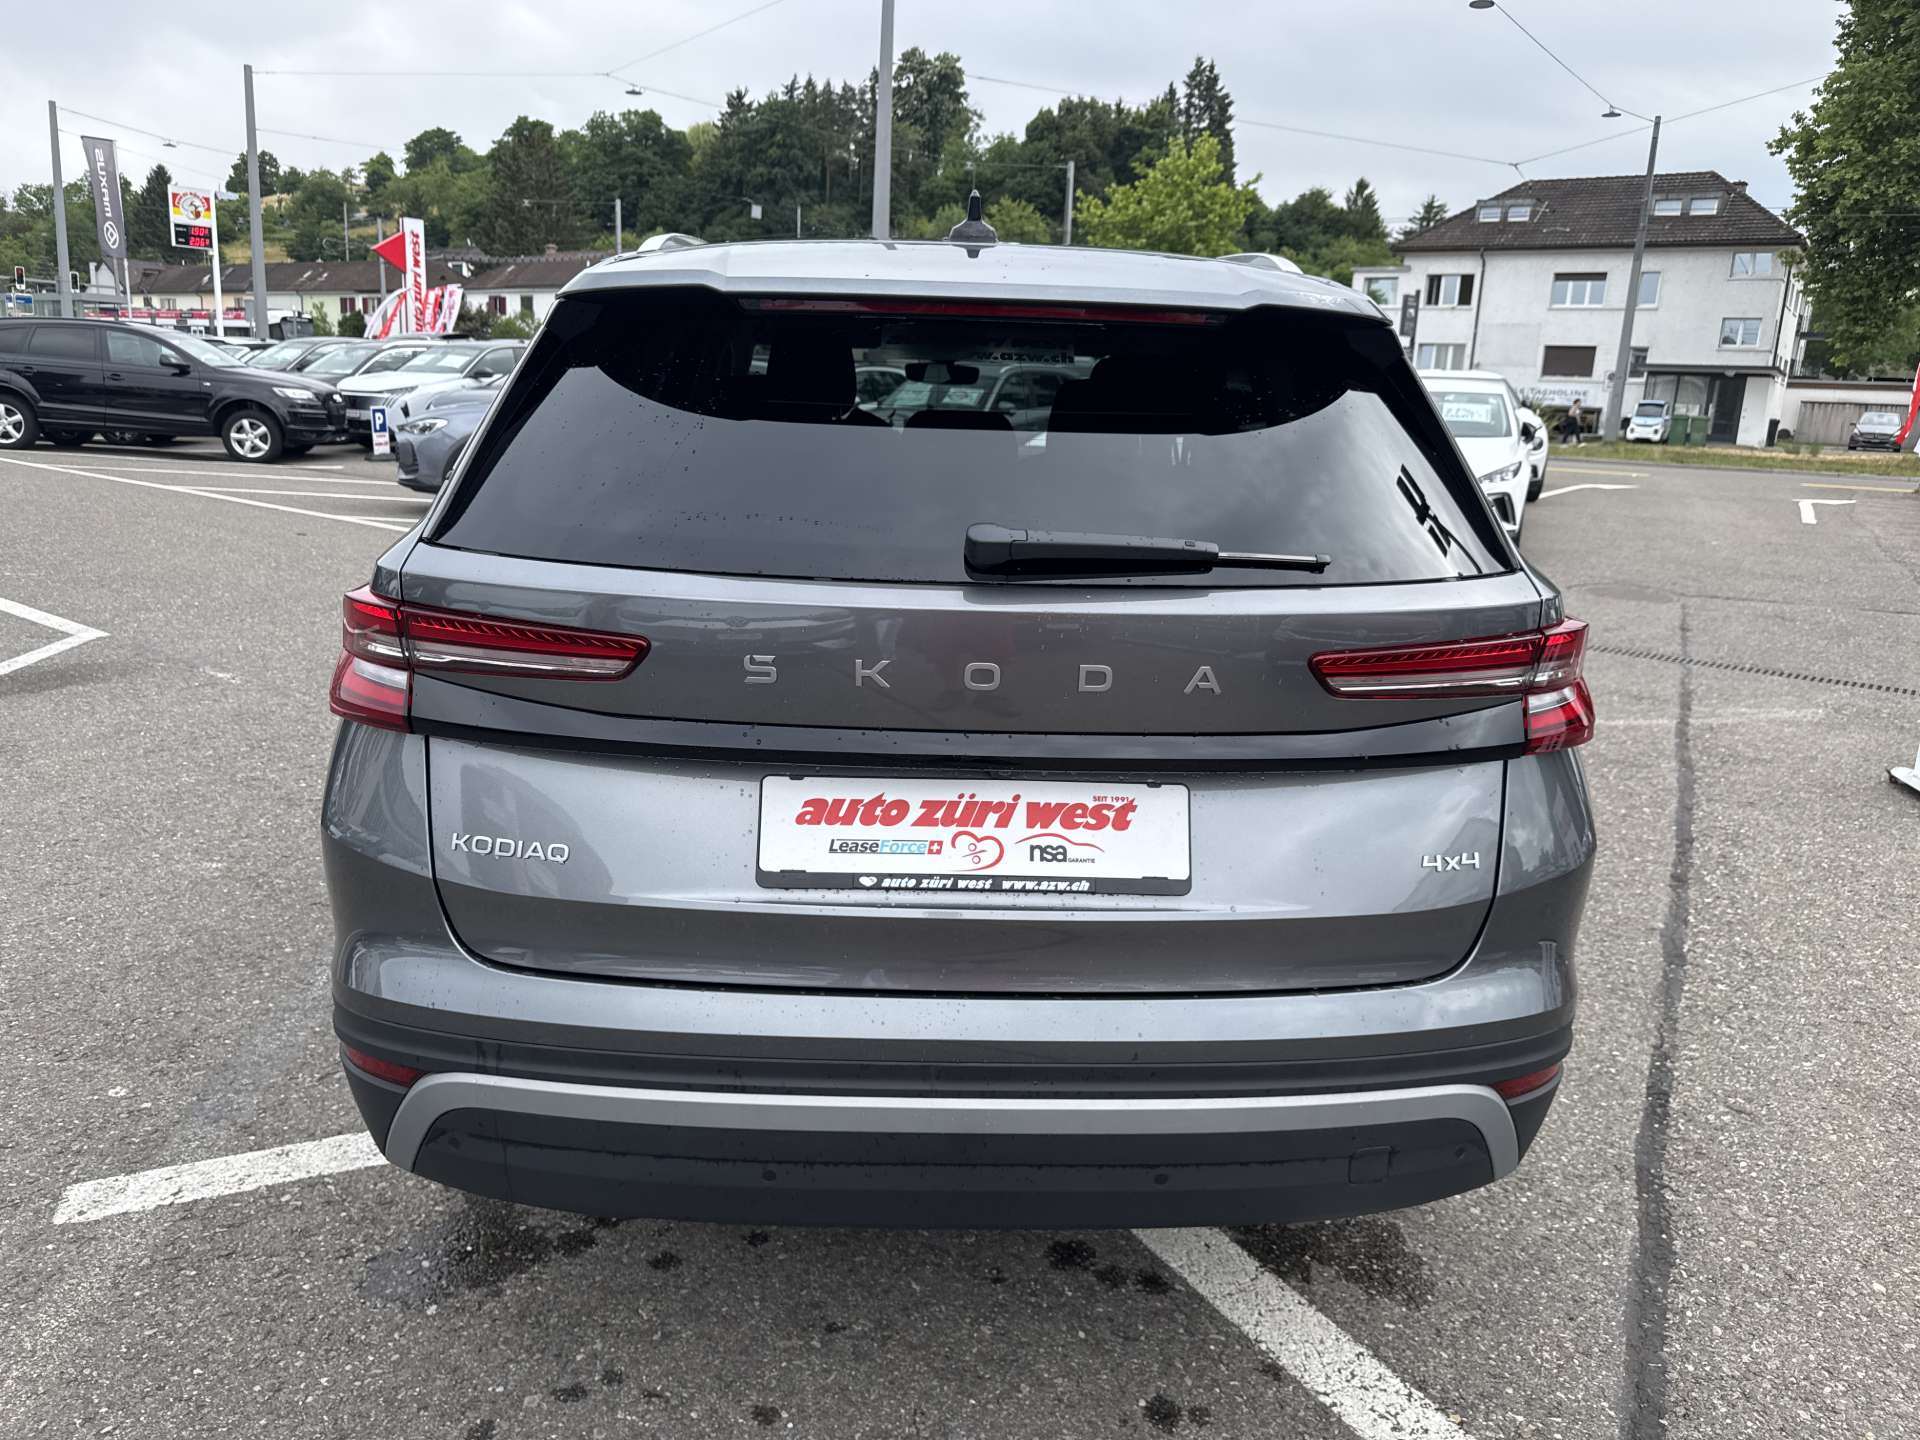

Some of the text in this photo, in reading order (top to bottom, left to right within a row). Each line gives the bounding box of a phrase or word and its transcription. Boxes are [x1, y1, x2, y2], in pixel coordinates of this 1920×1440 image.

[374, 411, 384, 431] P
[795, 792, 1138, 832] auto züri west
[451, 832, 570, 865] KODIAQ
[828, 838, 929, 854] LeaseForce
[1029, 844, 1068, 863] nsa
[1421, 852, 1480, 872] 4x4
[881, 876, 1091, 892] auto züri west www.azw.ch
